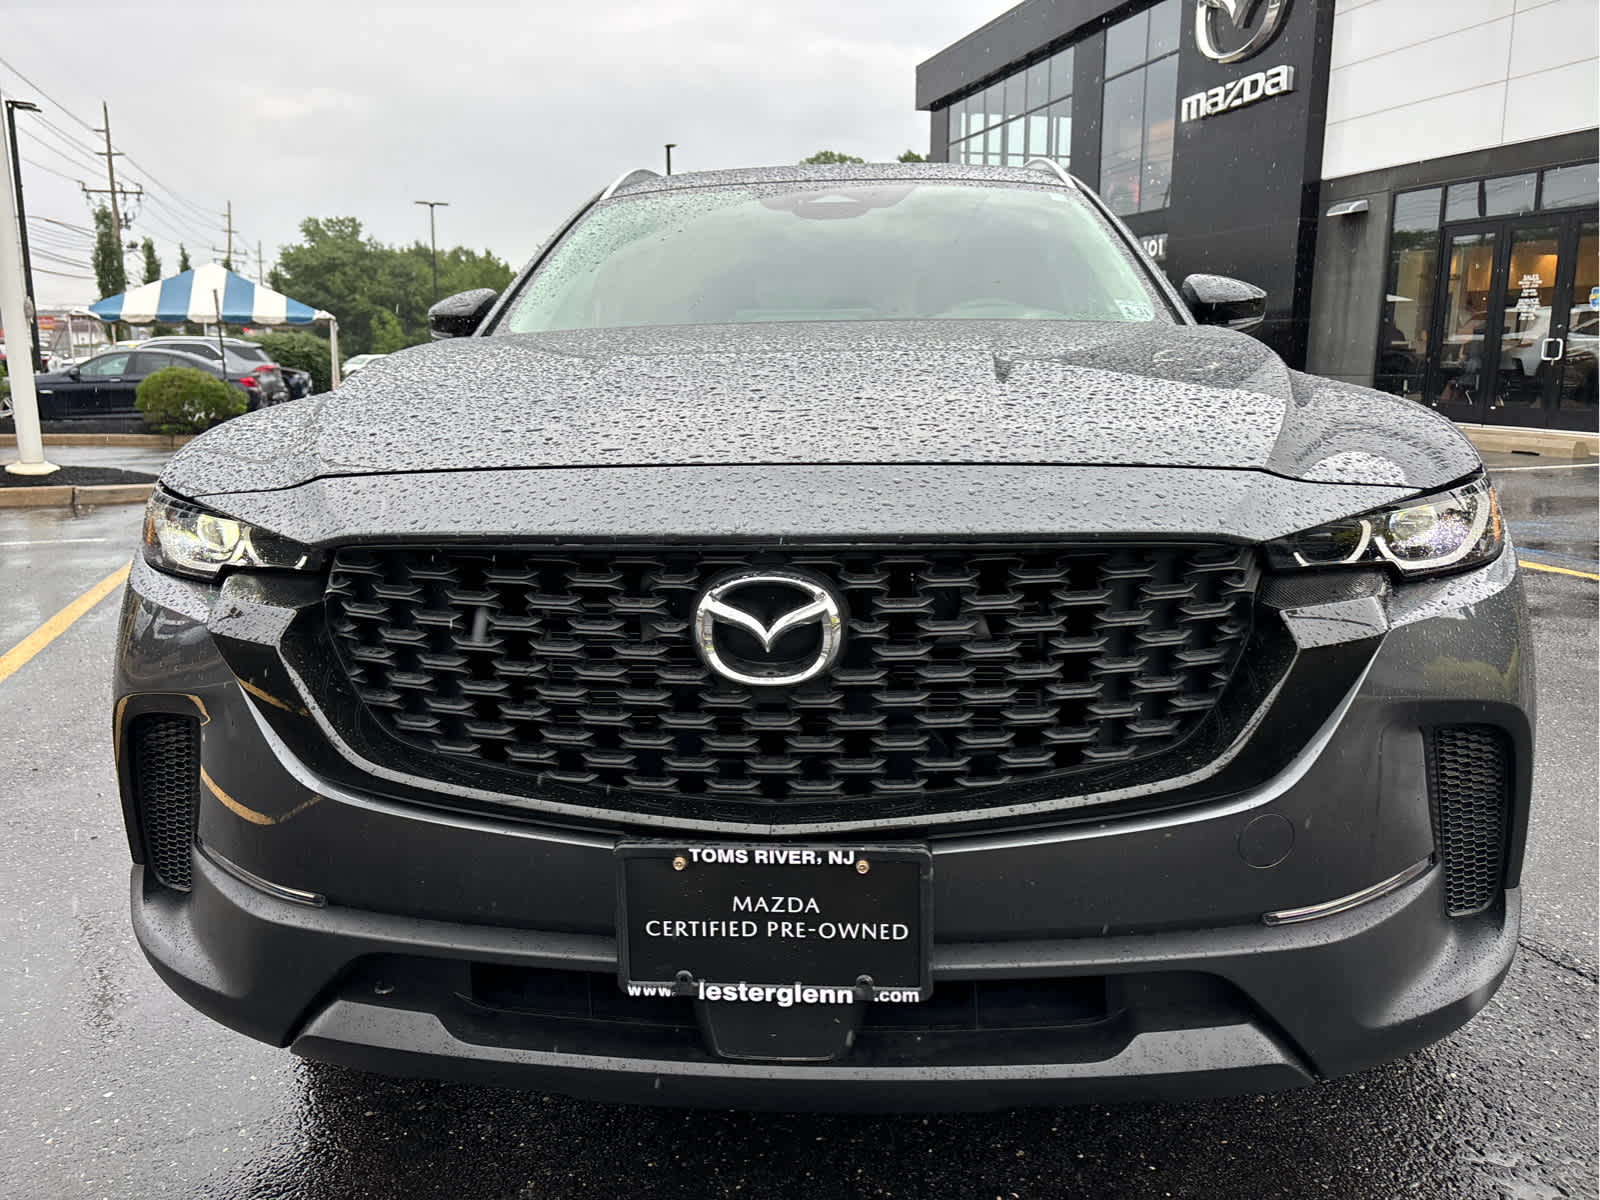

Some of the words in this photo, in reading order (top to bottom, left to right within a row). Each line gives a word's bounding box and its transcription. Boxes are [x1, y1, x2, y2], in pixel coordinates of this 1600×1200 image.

[688, 848, 749, 864] TOMS
[754, 850, 822, 865] RIVER,
[828, 850, 855, 865] NJ
[732, 896, 820, 914] MAZDA
[645, 920, 758, 937] CERTIFIED
[767, 921, 909, 940] PRE-OWNED
[699, 981, 854, 1007] lesterglenn
[873, 991, 920, 1003] .com
